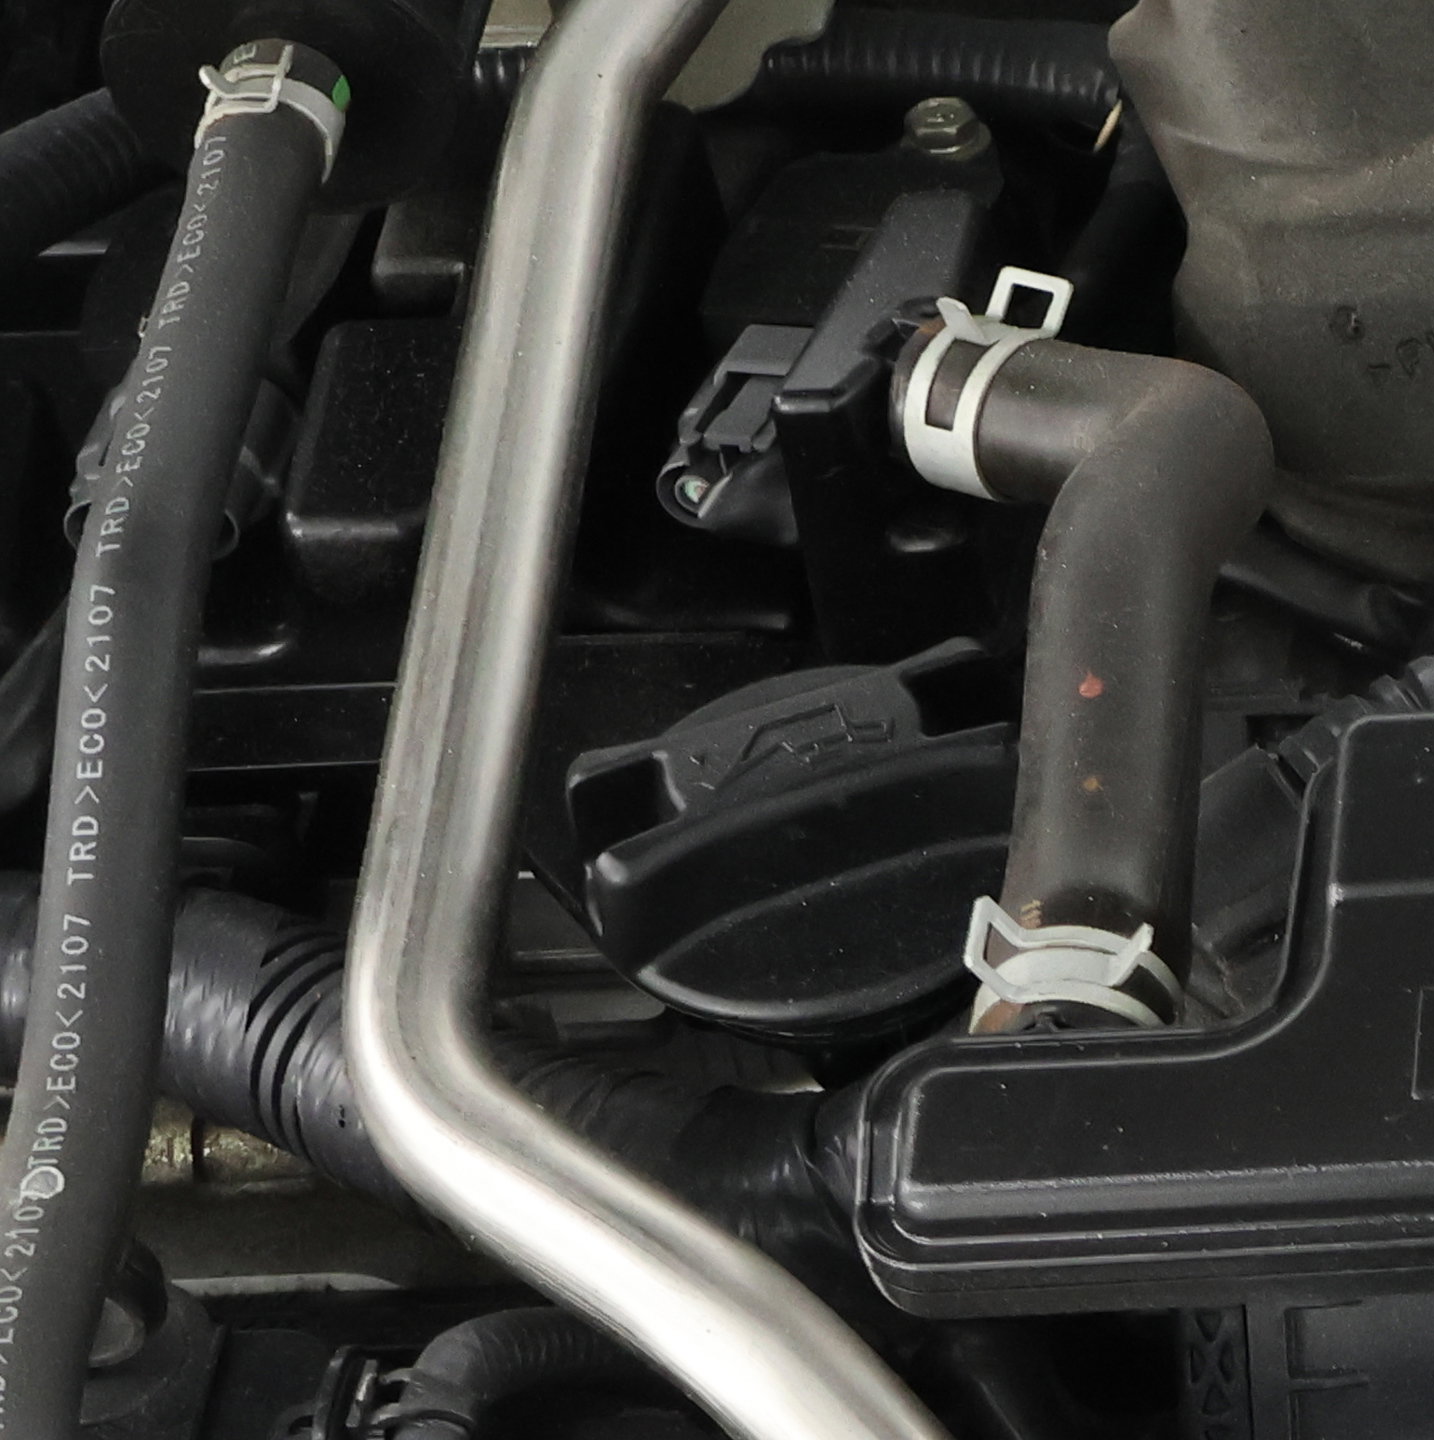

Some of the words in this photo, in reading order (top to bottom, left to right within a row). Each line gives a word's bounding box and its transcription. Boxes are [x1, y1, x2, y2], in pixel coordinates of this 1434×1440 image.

[67, 583, 117, 886] TRD>ECO<2107
[95, 344, 173, 559] TRD>ECO<2107
[157, 136, 227, 330] TRD>ECO<2107
